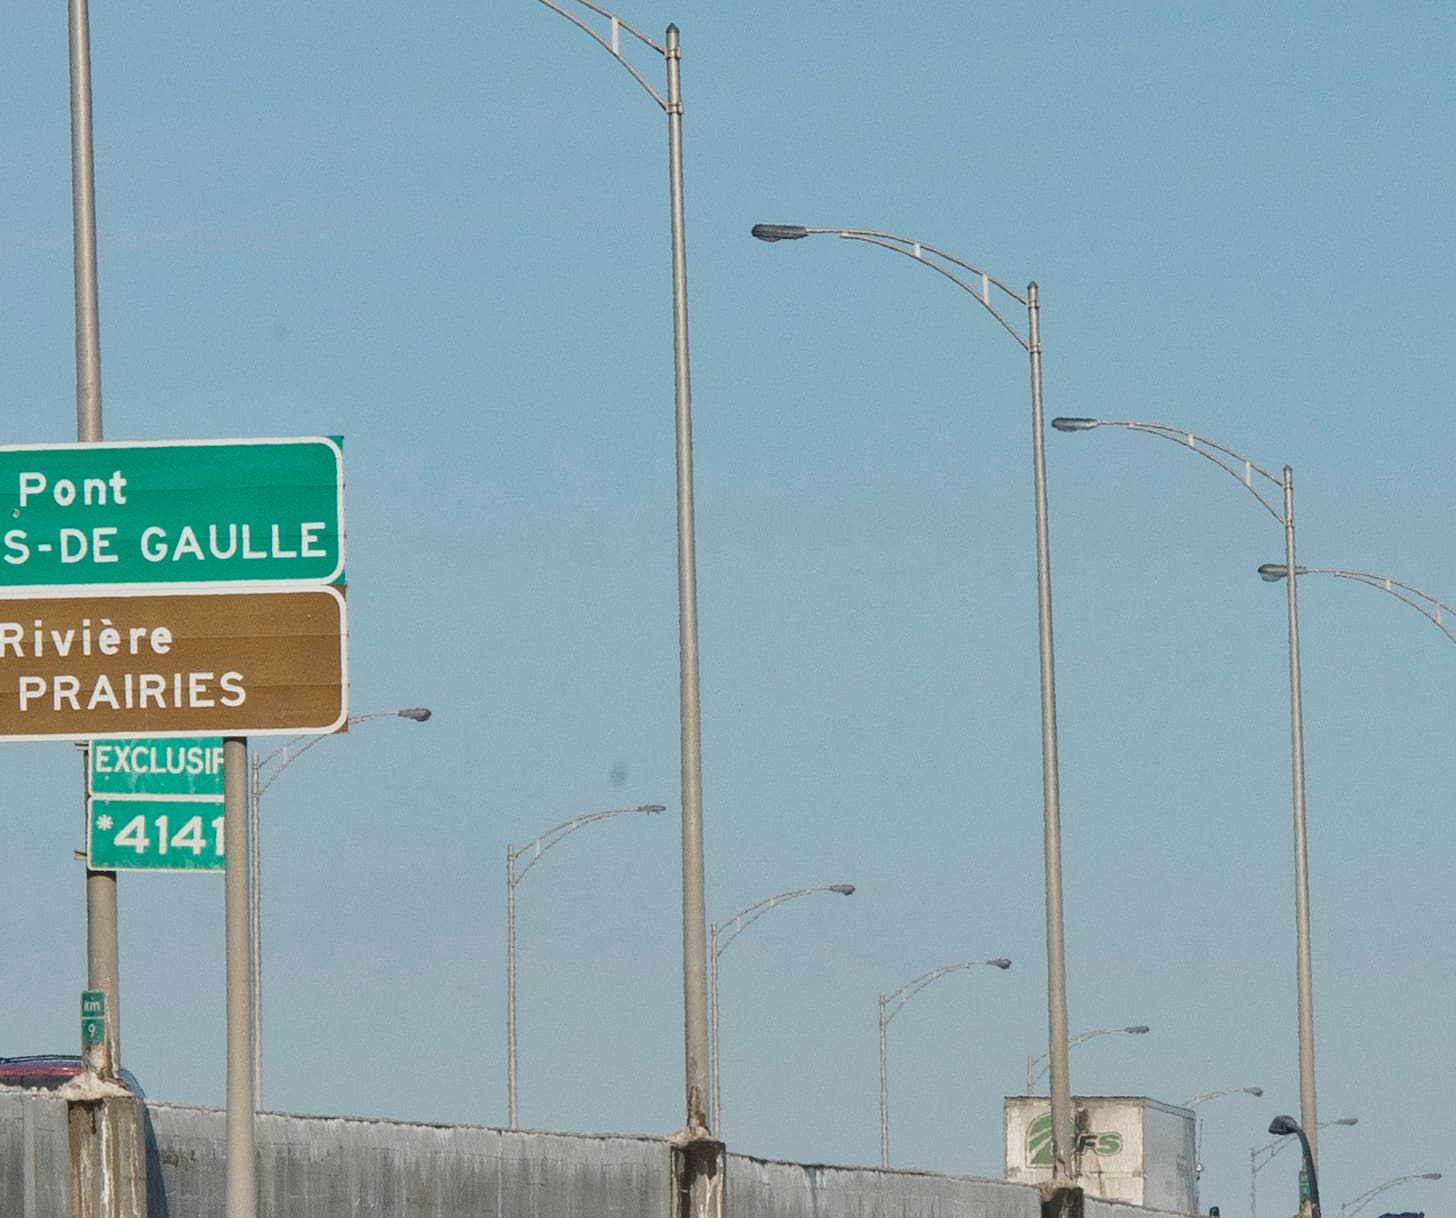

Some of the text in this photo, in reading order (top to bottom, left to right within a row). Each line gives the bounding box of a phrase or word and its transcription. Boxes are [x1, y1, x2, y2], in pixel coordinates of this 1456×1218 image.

[19, 471, 127, 507] Pont
[140, 521, 327, 563] GAULLE
[19, 671, 246, 712] PRAIRIES
[84, 1001, 101, 1011] km
[88, 1023, 96, 1038] 9
